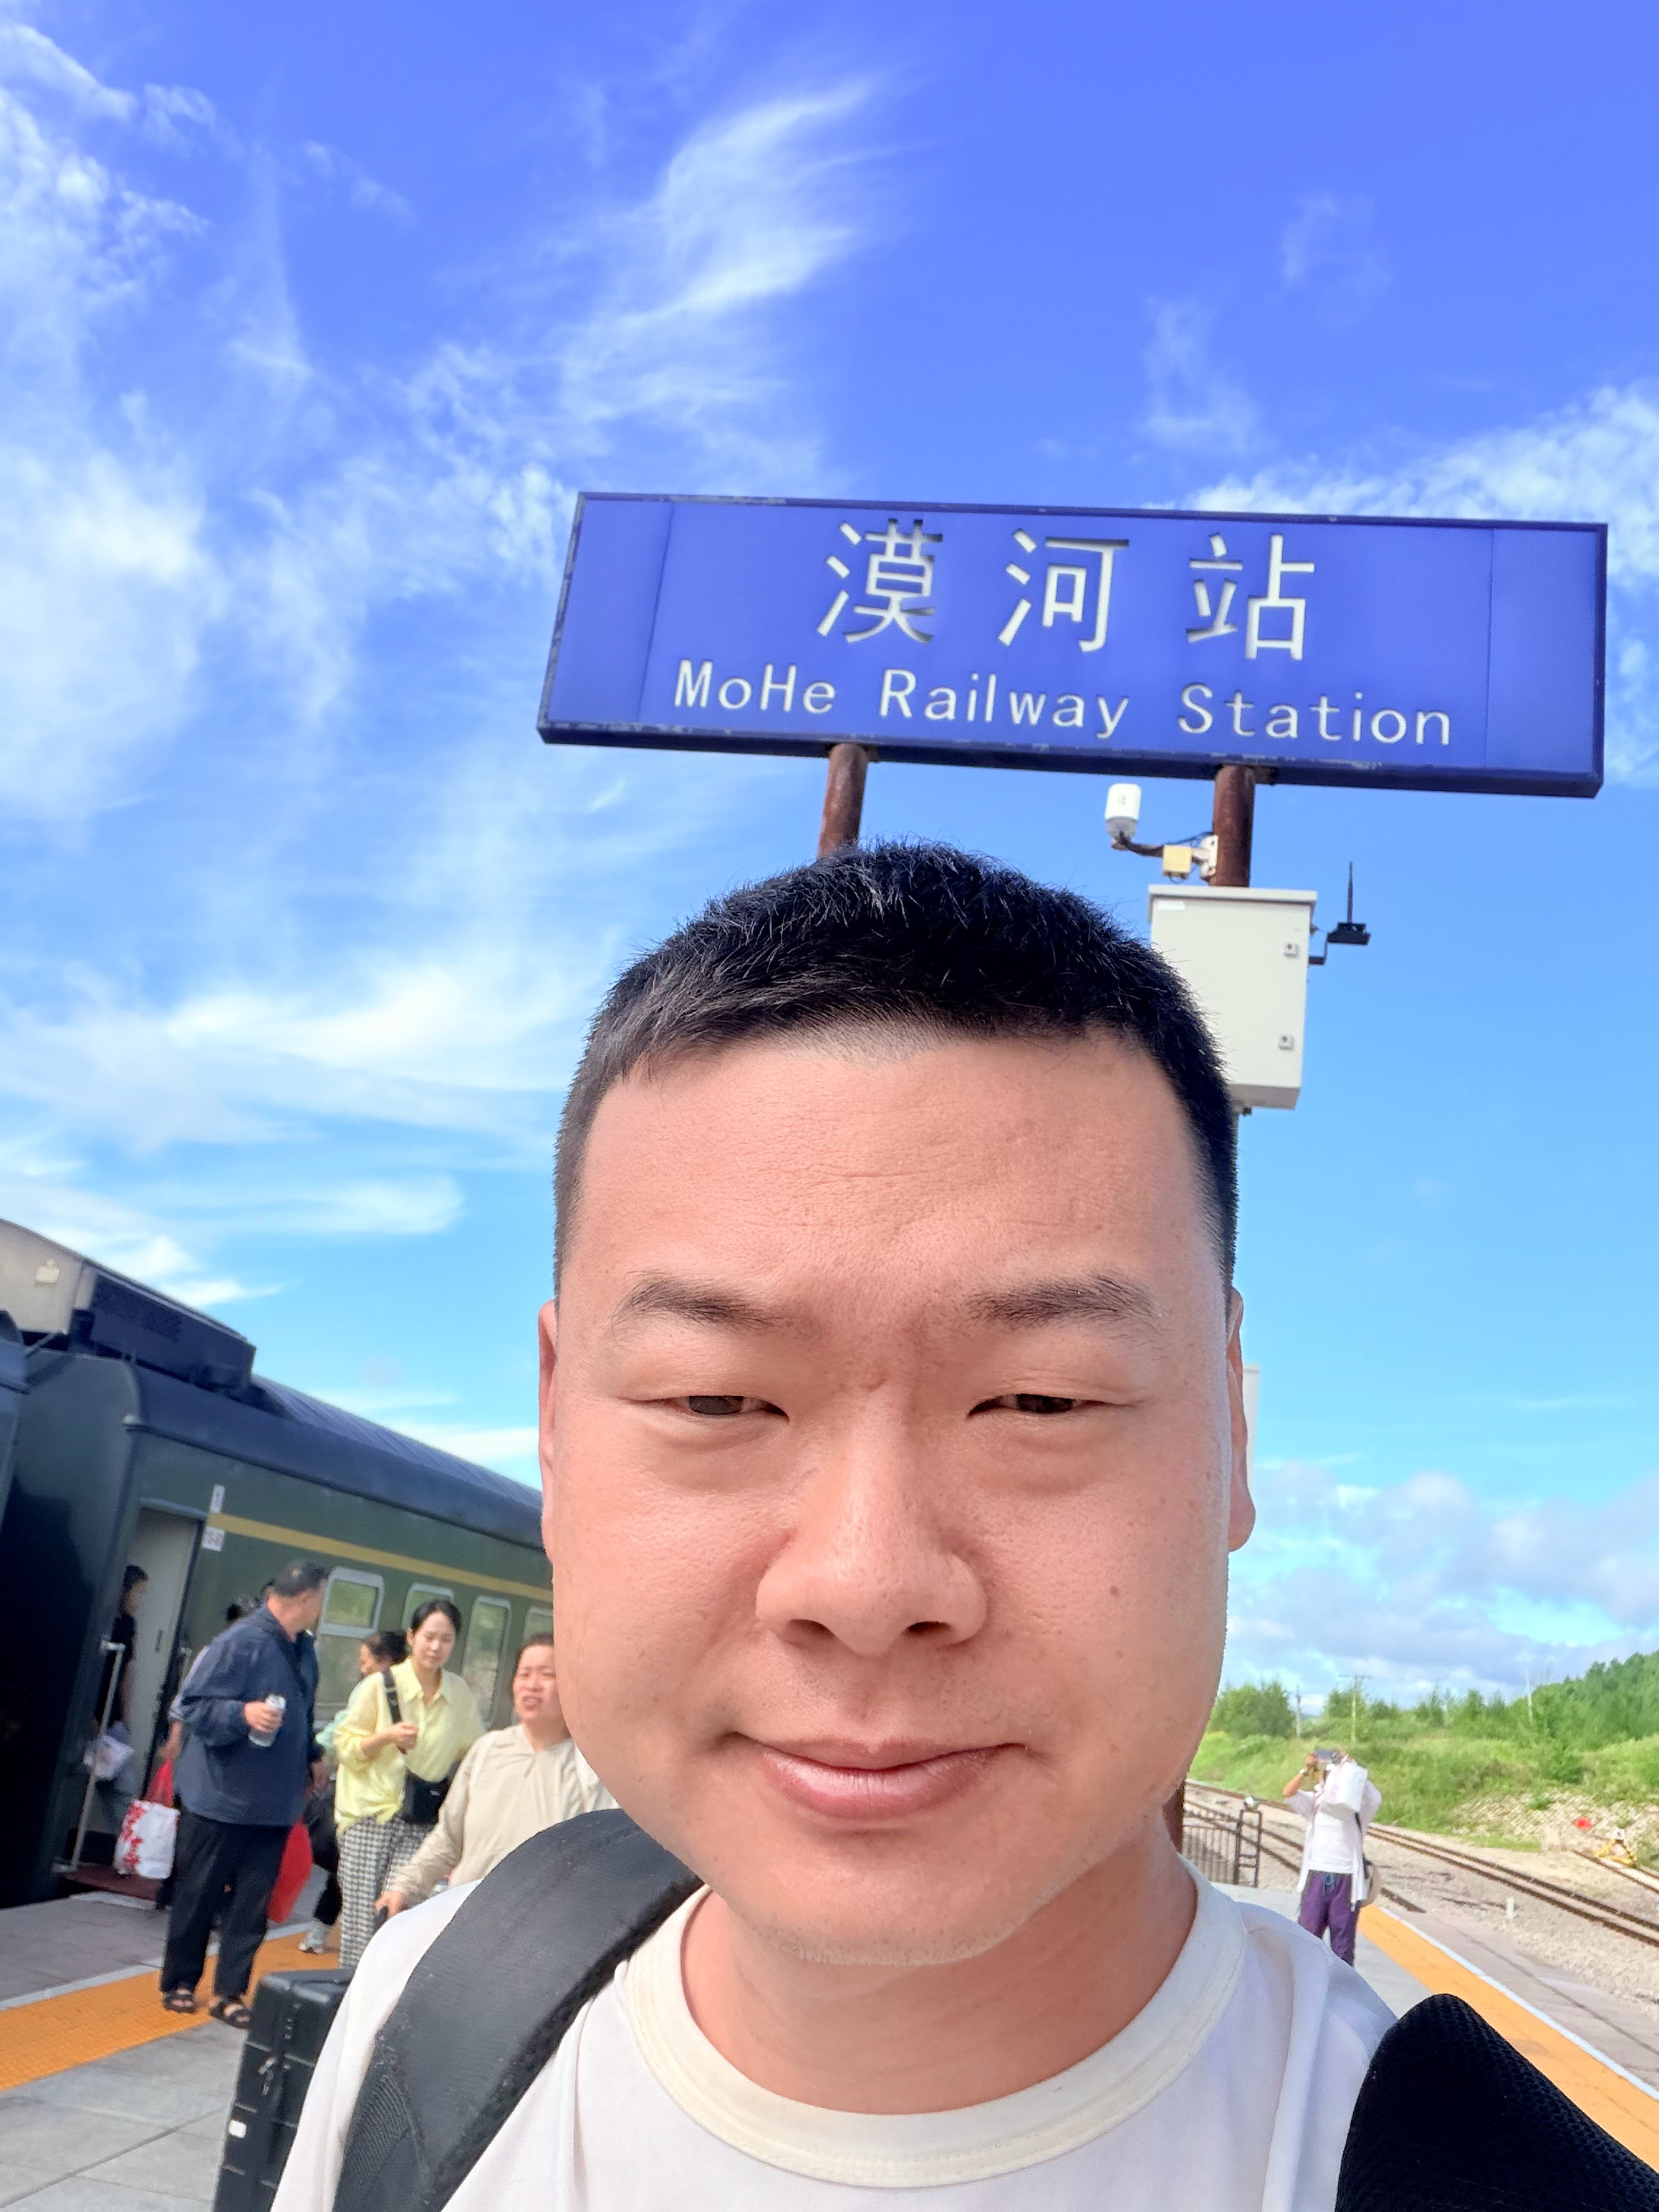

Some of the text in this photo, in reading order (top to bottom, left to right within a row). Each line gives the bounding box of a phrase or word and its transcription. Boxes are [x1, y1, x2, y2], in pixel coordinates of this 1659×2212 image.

[817, 518, 1316, 660] 漠河站
[673, 658, 1452, 746] MoHe Railway Station
